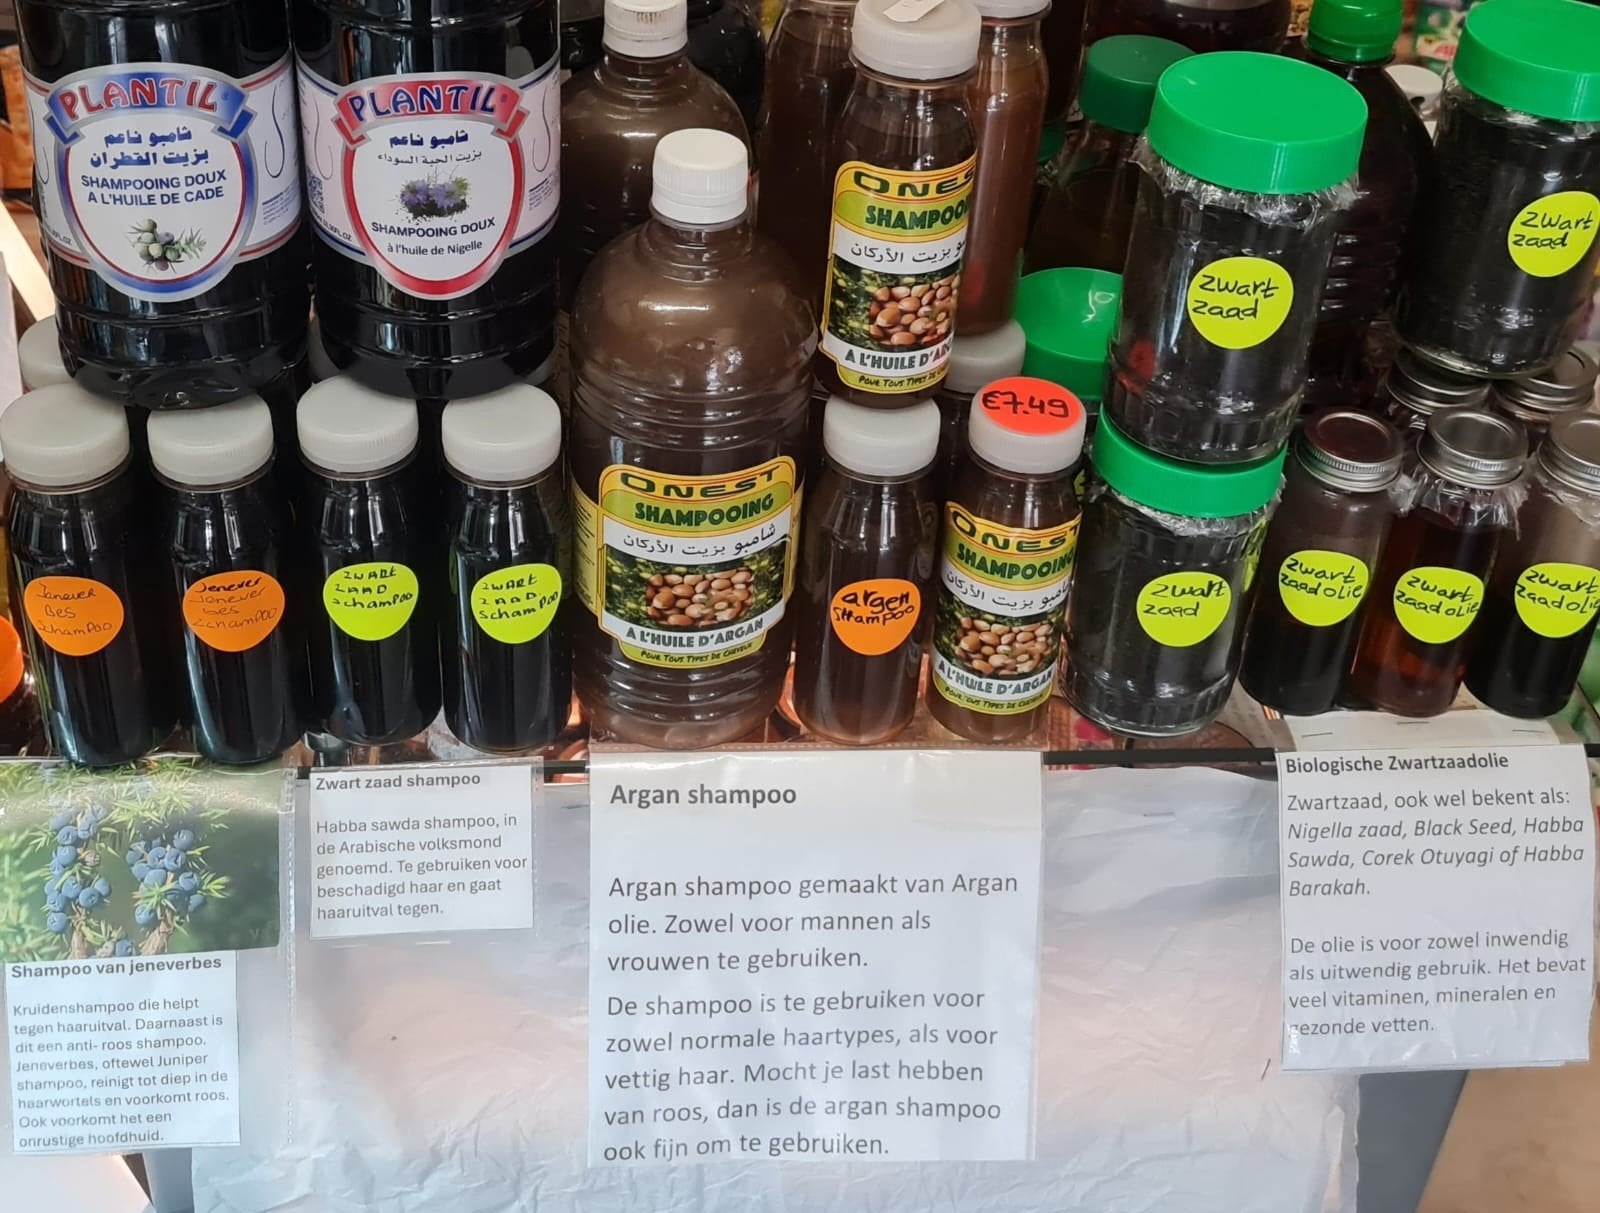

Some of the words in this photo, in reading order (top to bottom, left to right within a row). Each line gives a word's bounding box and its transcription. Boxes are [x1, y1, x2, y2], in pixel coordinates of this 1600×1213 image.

[58, 78, 217, 121] PLANTIL
[348, 86, 497, 122] PLANTIL
[104, 129, 142, 147] ناعم
[149, 125, 192, 147] شامبو
[390, 133, 423, 149] ناعم
[430, 129, 469, 149] شامبو
[163, 149, 208, 168] بزيت
[81, 174, 181, 191] SHAMPOOING
[184, 169, 226, 187] DOUX
[88, 192, 97, 204] A
[101, 193, 157, 206] L'HUILE
[160, 192, 181, 205] DE
[184, 186, 225, 203] CADE
[371, 220, 458, 238] SHAMPOOING
[460, 217, 496, 236] DOUX
[387, 242, 394, 254] à
[396, 244, 429, 256] l'huile
[431, 243, 444, 255] de
[447, 240, 483, 256] Nigelle
[982, 390, 1069, 418] €7.49
[620, 465, 781, 499] ONEST
[634, 493, 775, 527] SHAMPOOING
[623, 535, 674, 554] الأركان
[734, 524, 776, 556] شامبو
[681, 545, 726, 558] بزيت
[626, 626, 637, 640] A
[640, 630, 694, 648] L'HUILE
[698, 618, 763, 647] D'ARGAN
[938, 660, 946, 674] A
[947, 669, 993, 694] L'HUILE
[1286, 756, 1383, 776] Biologische
[1388, 752, 1509, 770] Zwartzaadolie
[315, 777, 362, 791] Zwart
[364, 774, 403, 790] zaad
[406, 773, 482, 789] shampoo
[610, 784, 679, 809] Argan
[688, 783, 796, 809] shampoo
[1288, 792, 1388, 811] Zwartzaad,
[1395, 790, 1428, 808] ook
[1434, 789, 1465, 807] wel
[1472, 789, 1535, 806] bekent
[1540, 787, 1570, 804] als:
[316, 818, 368, 834] Habba
[370, 816, 421, 832] sawda
[423, 815, 500, 831] shampoo,
[503, 812, 518, 827] in
[1288, 822, 1352, 843] Nigella
[1358, 820, 1407, 839] zaad,
[1414, 818, 1463, 836] Black
[1468, 817, 1516, 836] Seed,
[1524, 816, 1584, 834] Habba
[316, 841, 336, 856] de
[338, 838, 416, 854] Arabische
[418, 834, 502, 852] volksmond
[1288, 850, 1354, 869] Sawda,
[1362, 848, 1415, 866] Corek
[1421, 847, 1494, 868] Otuyagi
[1500, 845, 1520, 865] of
[1524, 845, 1584, 862] Habba
[316, 860, 394, 880] genoemd.
[396, 859, 414, 874] Te
[416, 857, 492, 876] gebruiken
[493, 857, 528, 870] voor
[317, 880, 406, 899] beschadigd
[409, 879, 444, 895] haar
[446, 881, 466, 893] en
[469, 878, 502, 895] gaat
[609, 877, 676, 902] Argan
[685, 875, 791, 900] shampoo
[799, 873, 898, 899] gemaakt
[905, 879, 944, 893] van
[952, 874, 1017, 896] Argan
[1289, 878, 1370, 896] Barakah.
[317, 903, 395, 921] haaruitval
[396, 903, 444, 919] tegen.
[608, 913, 656, 934] olie.
[664, 912, 733, 934] Zowel
[741, 917, 794, 932] voor
[801, 916, 893, 930] mannen
[902, 910, 930, 930] als
[11, 964, 93, 980] Shampoo
[95, 963, 126, 975] van
[128, 956, 223, 977] jeneverbes
[607, 956, 709, 971] vrouwen
[717, 952, 740, 970] te
[747, 947, 868, 974] gebruiken.
[1289, 965, 1314, 980] als
[1321, 961, 1411, 981] uitwendig
[1417, 959, 1491, 980] gebruik.
[1498, 959, 1530, 974] Het
[1537, 957, 1586, 973] bevat
[12, 1001, 135, 1017] Kruidenshampoo
[137, 997, 160, 1012] die
[162, 996, 200, 1012] helpt
[1289, 991, 1326, 1008] veel
[1332, 989, 1429, 1007] vitaminen,
[1436, 985, 1528, 1003] mineralen
[1534, 987, 1555, 1000] en
[15, 1042, 34, 1054] dit
[36, 1042, 63, 1053] een
[66, 1038, 99, 1052] anti-
[101, 1039, 133, 1052] roos
[135, 1035, 207, 1050] shampoo.
[606, 1032, 672, 1053] zowel
[681, 1028, 775, 1050] normale
[784, 1027, 900, 1048] haartypes,
[909, 1024, 938, 1043] als
[946, 1029, 998, 1044] voor
[17, 1079, 88, 1092] shampoo,
[90, 1074, 135, 1091] reinigt
[137, 1074, 158, 1087] tot
[160, 1072, 192, 1087] diep
[194, 1071, 208, 1084] in
[210, 1070, 229, 1083] de
[18, 1095, 102, 1110] haarwortels
[104, 1096, 123, 1107] en
[124, 1091, 193, 1107] voorkomt
[194, 1091, 230, 1102] roos.
[18, 1115, 48, 1129] Ook
[50, 1113, 117, 1128] voorkomt
[119, 1112, 143, 1125] het
[145, 1112, 173, 1124] een
[18, 1134, 85, 1150] onrustige
[87, 1128, 165, 1145] hoofdhuid.
